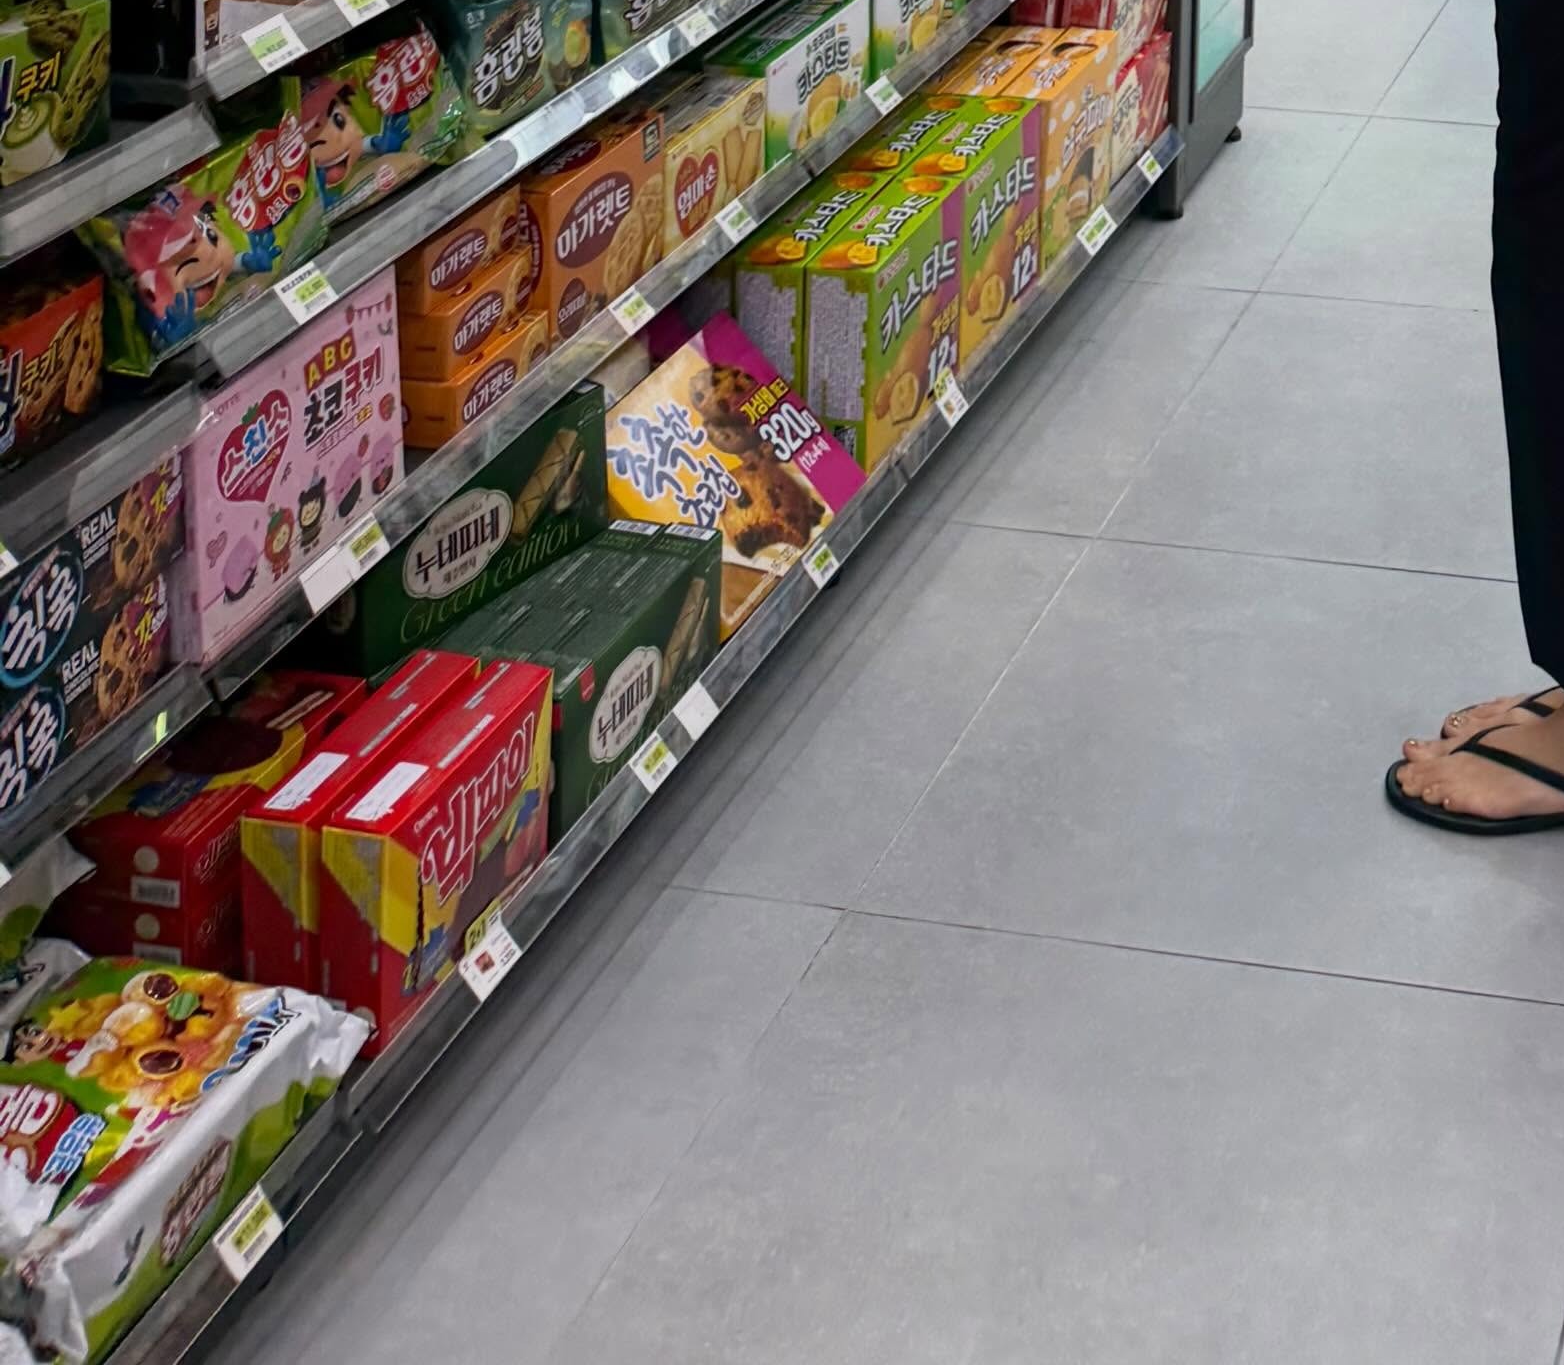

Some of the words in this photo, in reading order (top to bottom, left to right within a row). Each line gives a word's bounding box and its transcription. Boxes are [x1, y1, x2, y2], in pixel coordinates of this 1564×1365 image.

[16, 52, 62, 103] 쿠키
[472, 4, 546, 107] 홈런볼
[676, 163, 719, 221] 엄마손
[865, 194, 936, 247] 카스타드
[970, 155, 1036, 255] 카스타드
[555, 183, 632, 260] 마가렛트
[430, 234, 486, 286] 마가렛트
[453, 297, 504, 350] 마가렛트
[881, 238, 958, 355] 카스타드
[22, 341, 60, 390] 쿠키
[307, 335, 354, 390] ABC
[303, 345, 383, 449] 초코쿠키
[463, 364, 516, 421] 마가렛트
[605, 402, 705, 500] 촉촉한
[758, 402, 822, 464] 320g
[675, 454, 743, 529] 초코칩
[80, 505, 118, 550] REAL
[492, 520, 582, 587] edition
[62, 639, 100, 686] REAL
